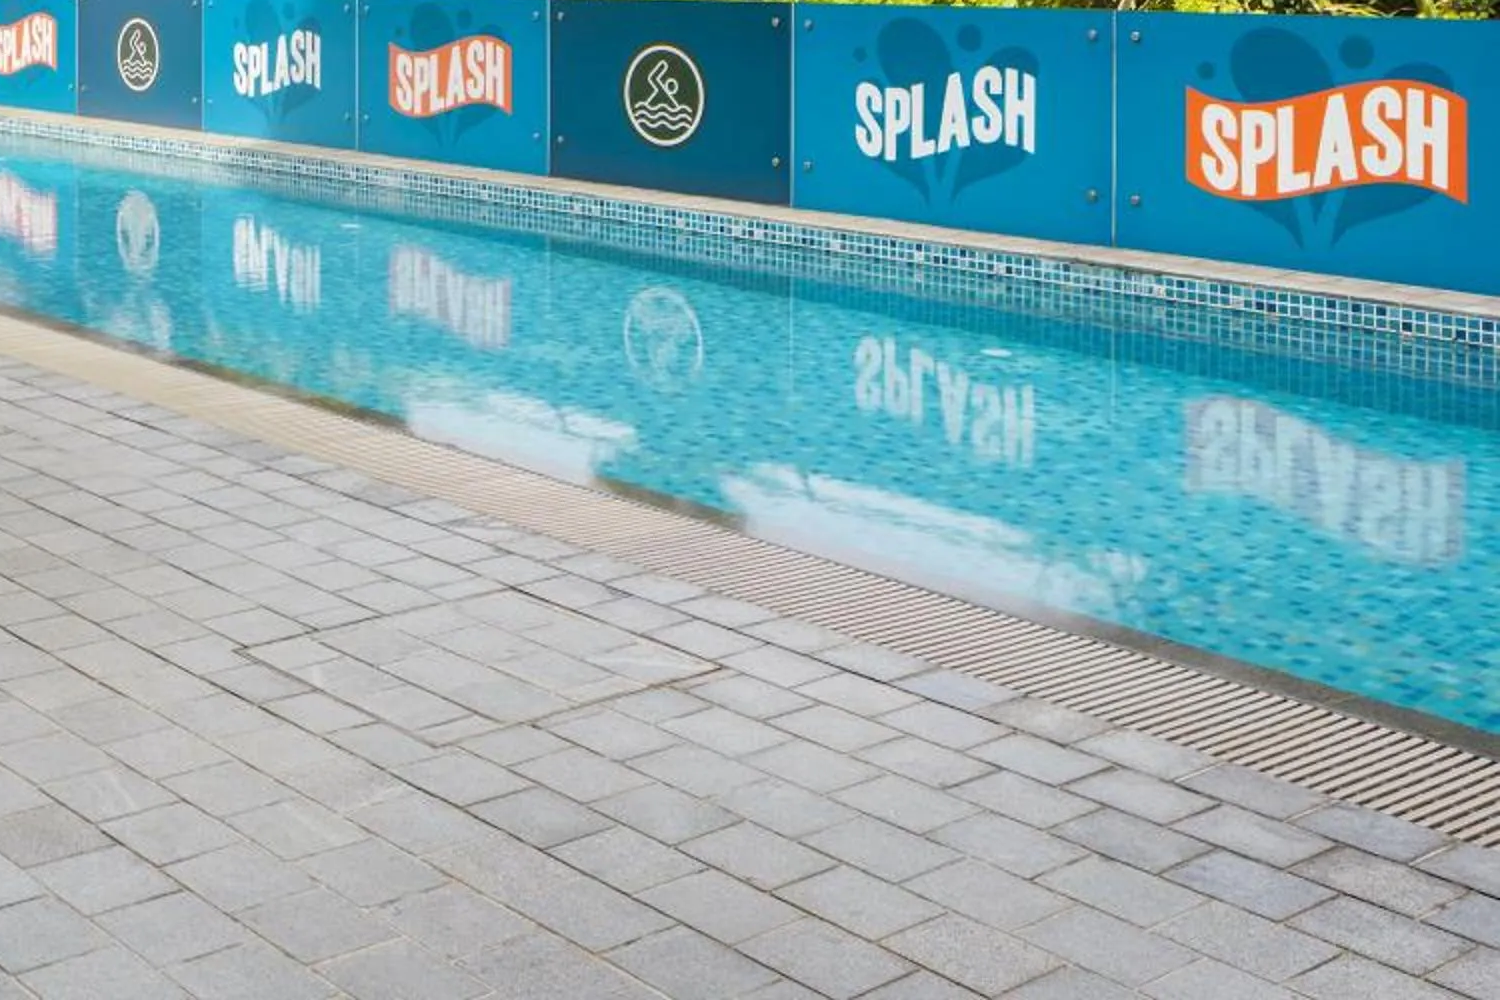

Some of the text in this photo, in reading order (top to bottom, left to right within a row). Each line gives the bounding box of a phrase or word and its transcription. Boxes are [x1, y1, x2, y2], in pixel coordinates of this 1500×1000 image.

[233, 30, 321, 98] SPLASH
[396, 42, 504, 112] SPLASH
[855, 65, 1035, 161] SPLASH
[1201, 87, 1448, 196] SPLASH
